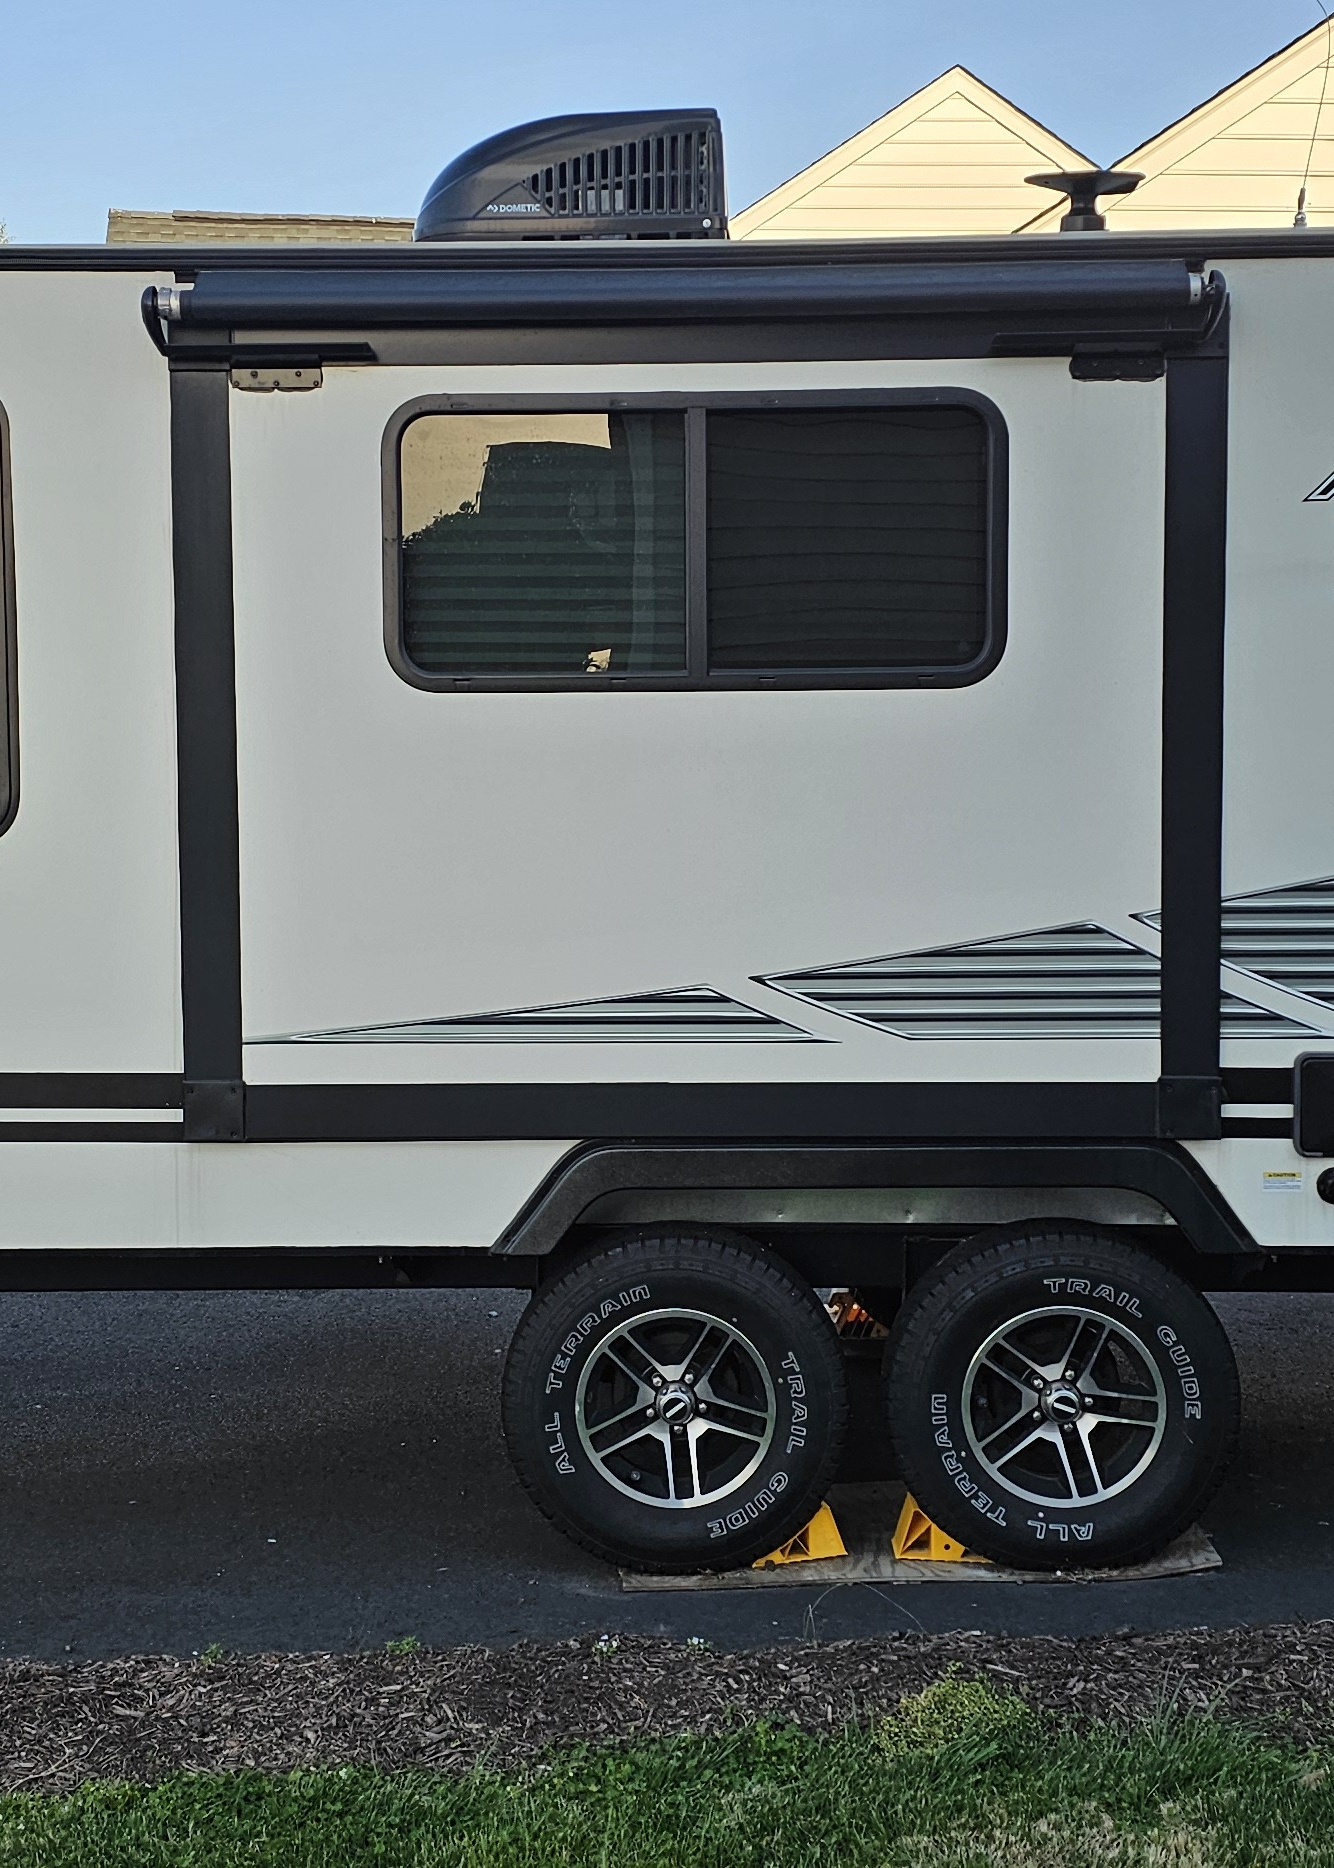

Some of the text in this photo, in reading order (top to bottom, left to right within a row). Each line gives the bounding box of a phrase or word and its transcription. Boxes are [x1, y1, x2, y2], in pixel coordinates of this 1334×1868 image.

[499, 203, 541, 213] DOMETIC
[544, 1284, 651, 1475] ALL TERRAIN
[1043, 1277, 1202, 1420] TRAIL GUIDE
[707, 1351, 808, 1539] TRAIL GUIDE
[931, 1393, 1093, 1541] ALL TERRAIN
